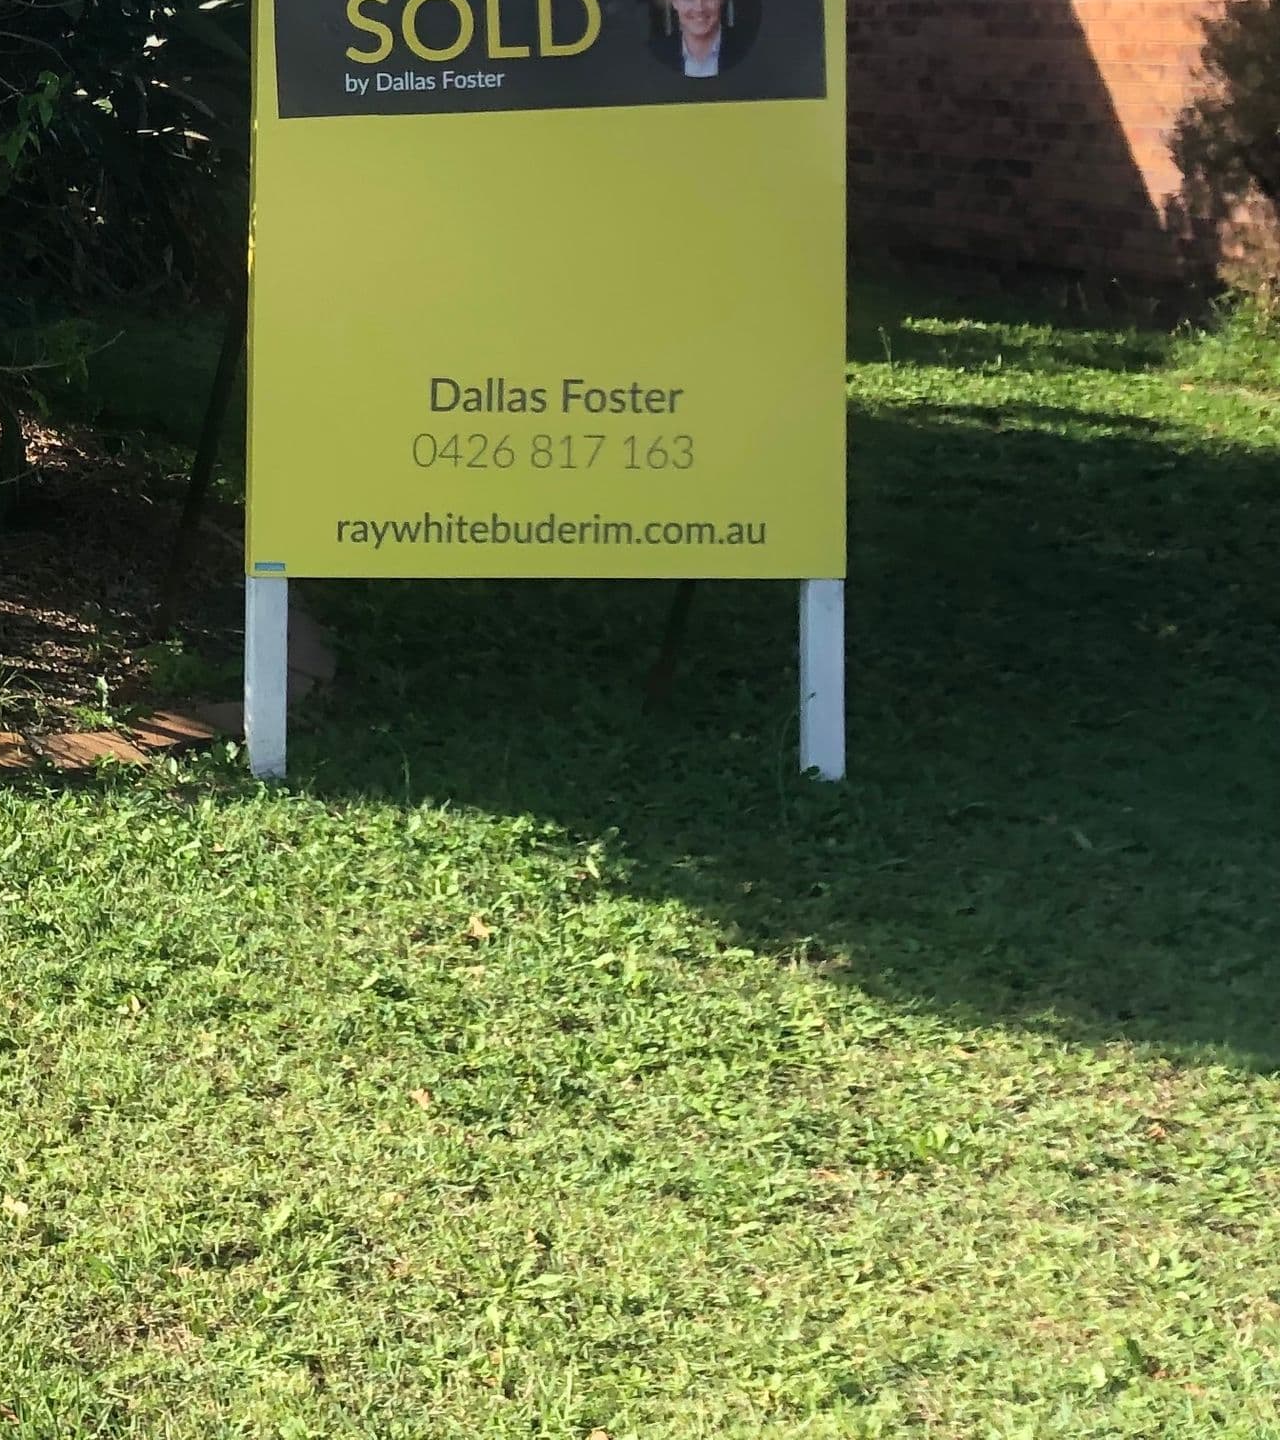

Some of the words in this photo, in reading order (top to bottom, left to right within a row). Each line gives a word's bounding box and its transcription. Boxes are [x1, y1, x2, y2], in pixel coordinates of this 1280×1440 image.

[345, 74, 369, 96] by
[376, 70, 436, 92] Dallas
[443, 68, 505, 90] Foster
[429, 378, 547, 414] Dallas
[563, 379, 684, 414] Foster
[412, 433, 516, 469] 0426
[531, 435, 606, 469] 817
[624, 435, 694, 470] 163
[337, 512, 766, 548] raywhitebuderim.com.au
